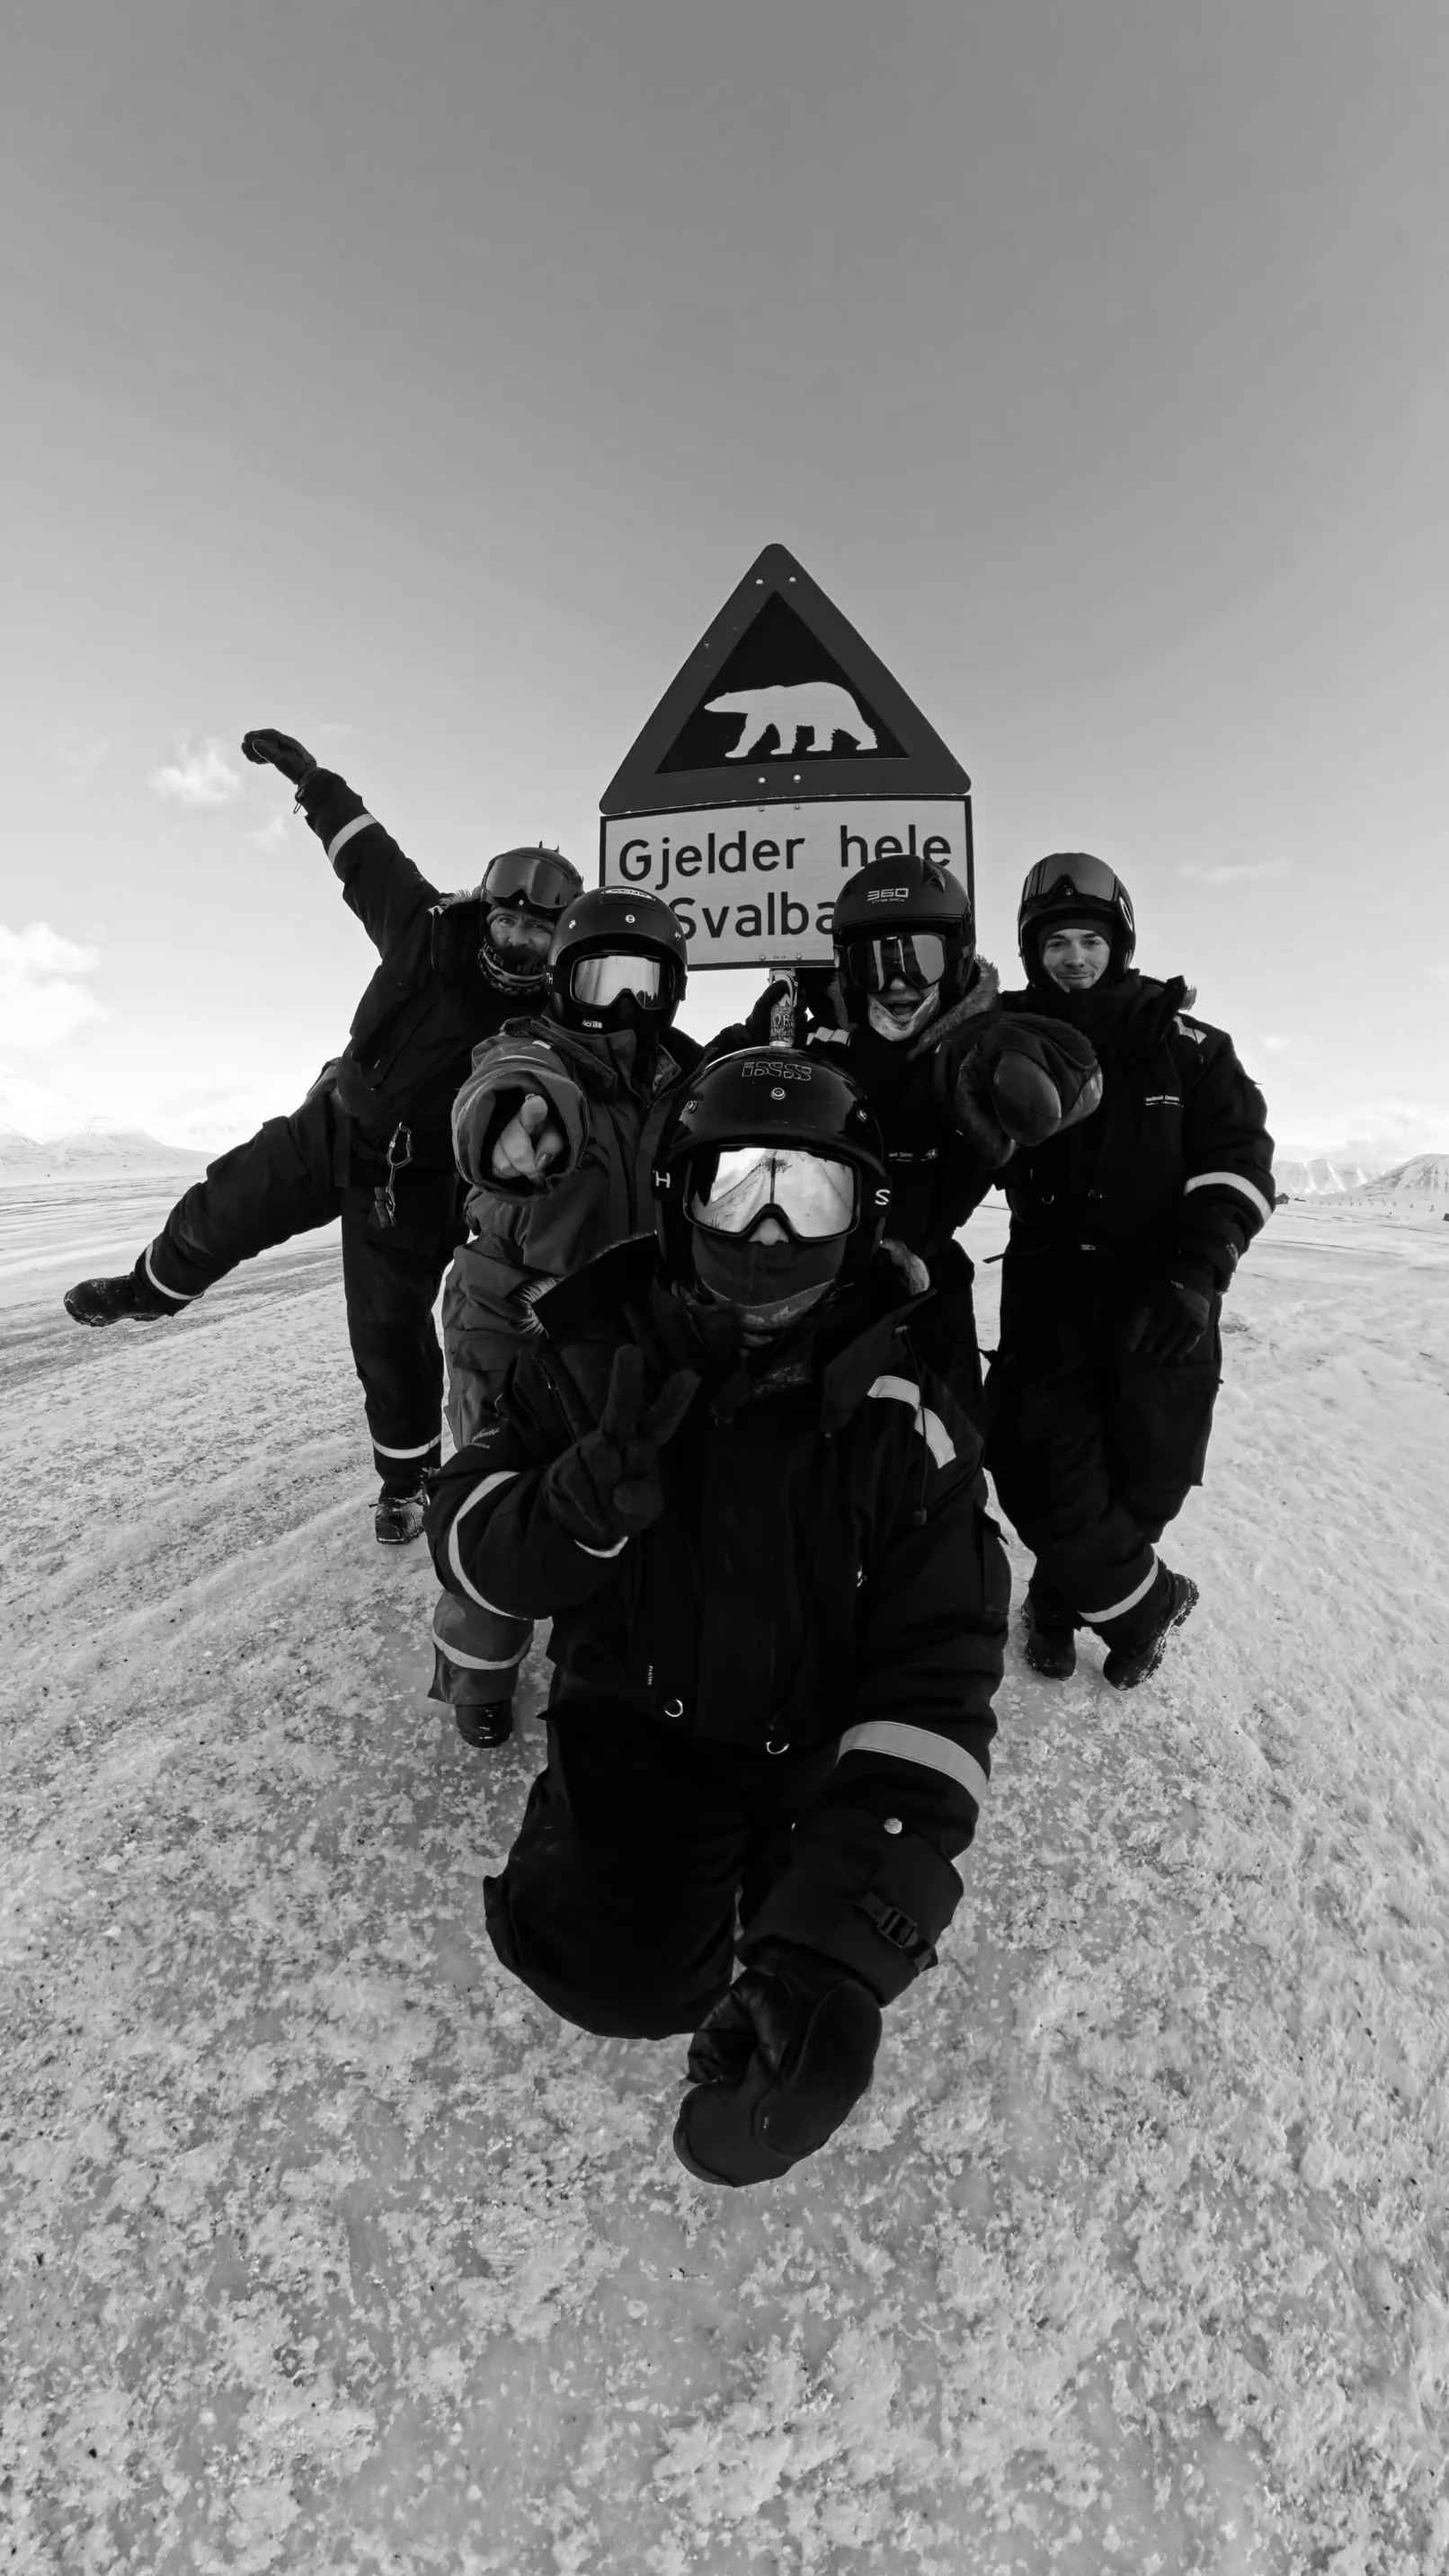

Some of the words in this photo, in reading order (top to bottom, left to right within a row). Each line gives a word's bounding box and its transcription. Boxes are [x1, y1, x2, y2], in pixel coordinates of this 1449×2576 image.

[619, 830, 805, 891] Gjelder
[840, 823, 952, 867] hele
[669, 891, 835, 941] Svalba
[867, 887, 910, 902] 360
